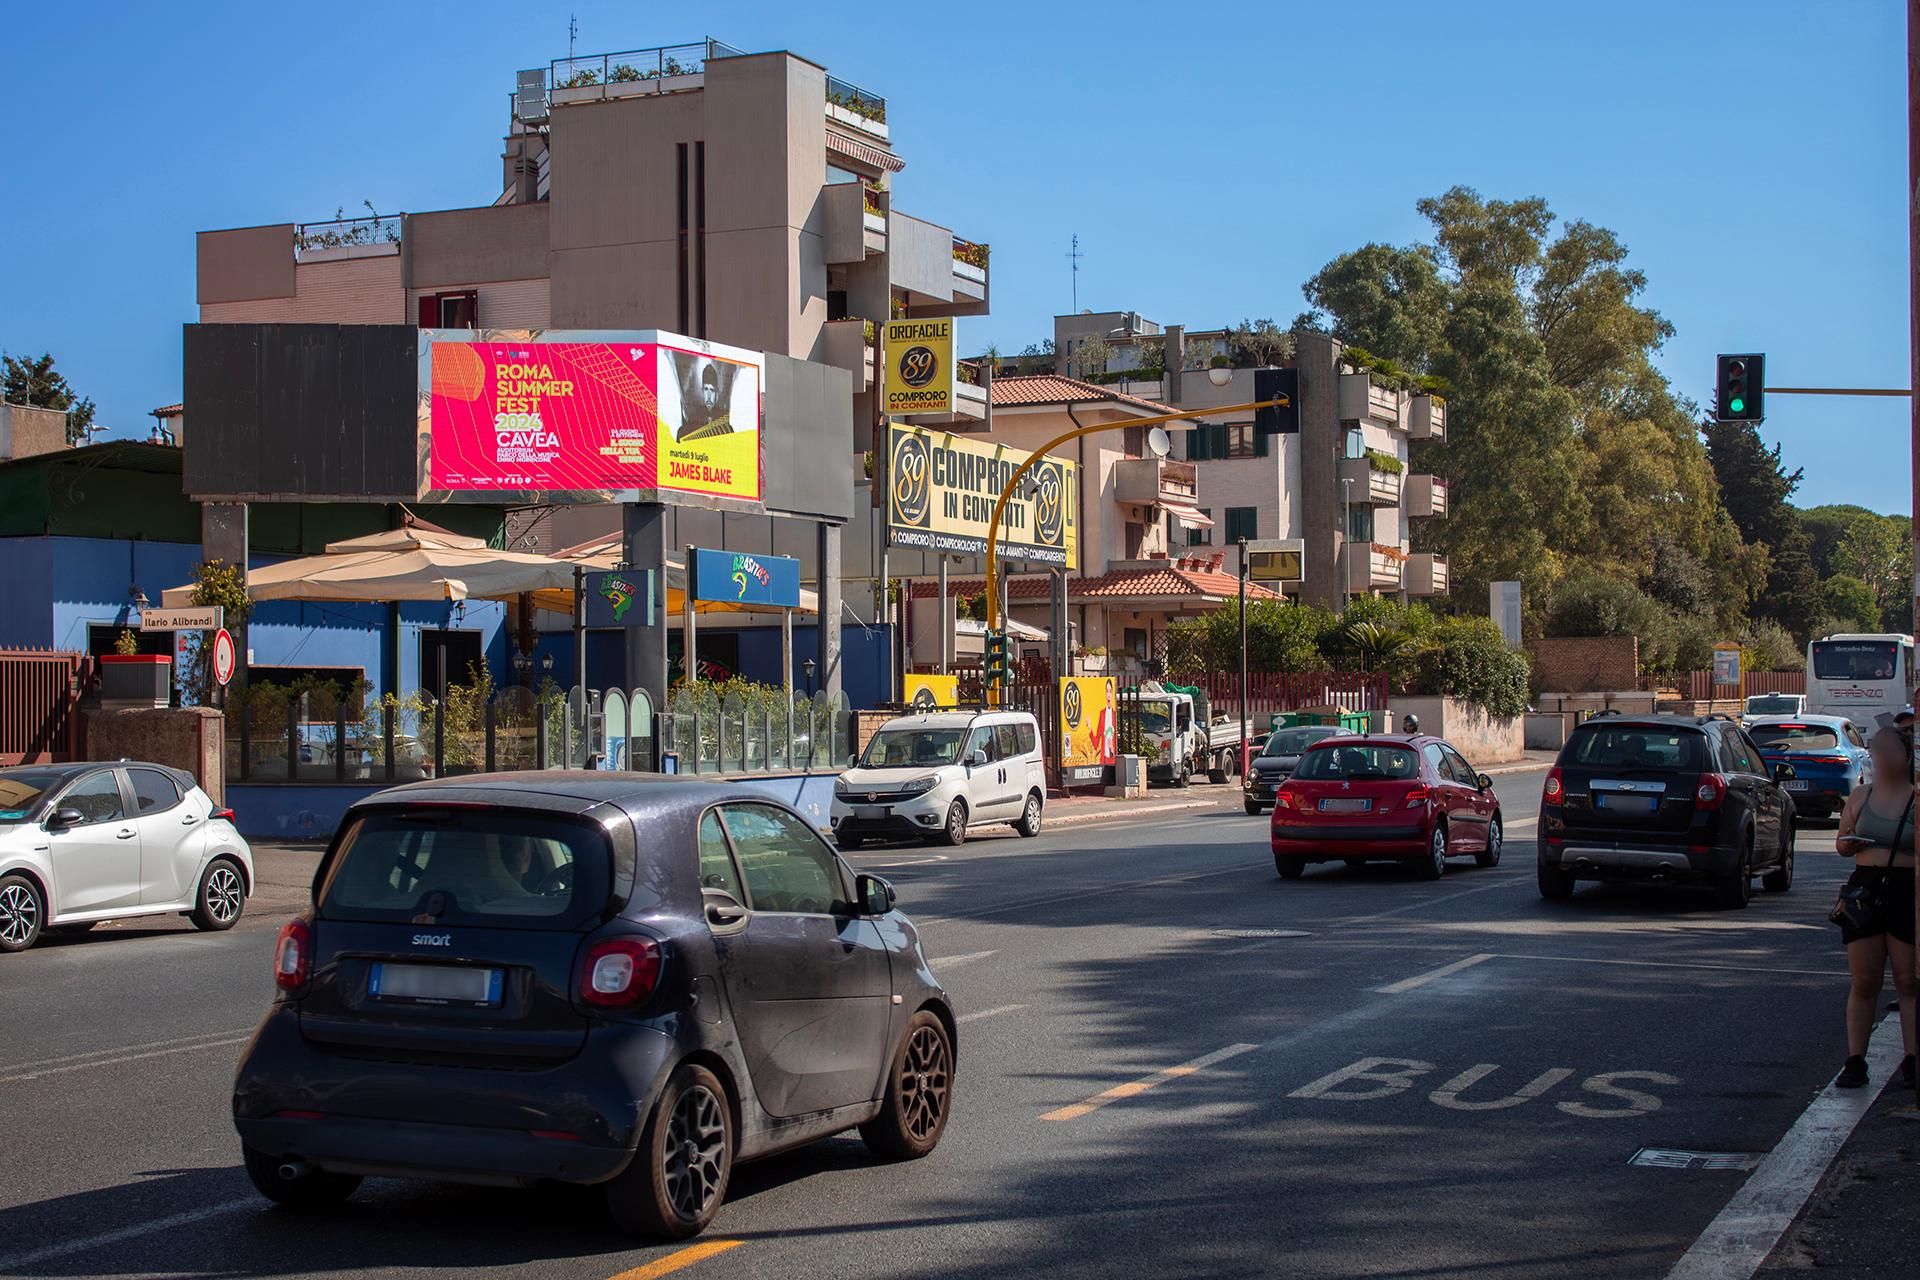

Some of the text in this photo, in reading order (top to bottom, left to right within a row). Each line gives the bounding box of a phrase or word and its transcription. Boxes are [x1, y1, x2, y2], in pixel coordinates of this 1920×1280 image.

[890, 323, 948, 339] OROFACILE
[496, 364, 553, 379] ROMA
[903, 352, 932, 379] 89
[496, 381, 574, 396] SUMMER
[889, 391, 947, 402] COMPRORO
[496, 398, 541, 412] FEST
[496, 413, 542, 431] 2024
[496, 432, 560, 447] CAVEA
[691, 451, 694, 460] 9
[695, 452, 709, 463] luglio
[670, 462, 732, 485] JAMES BLAKE
[897, 453, 925, 504] 89
[943, 491, 957, 519] IN
[1038, 481, 1058, 526] 89
[898, 532, 929, 546] COMPRORO
[145, 617, 212, 627] Ilario Alibrandi
[1065, 689, 1079, 719] 89
[412, 934, 451, 946] smart
[1286, 1055, 1684, 1118] BUS
